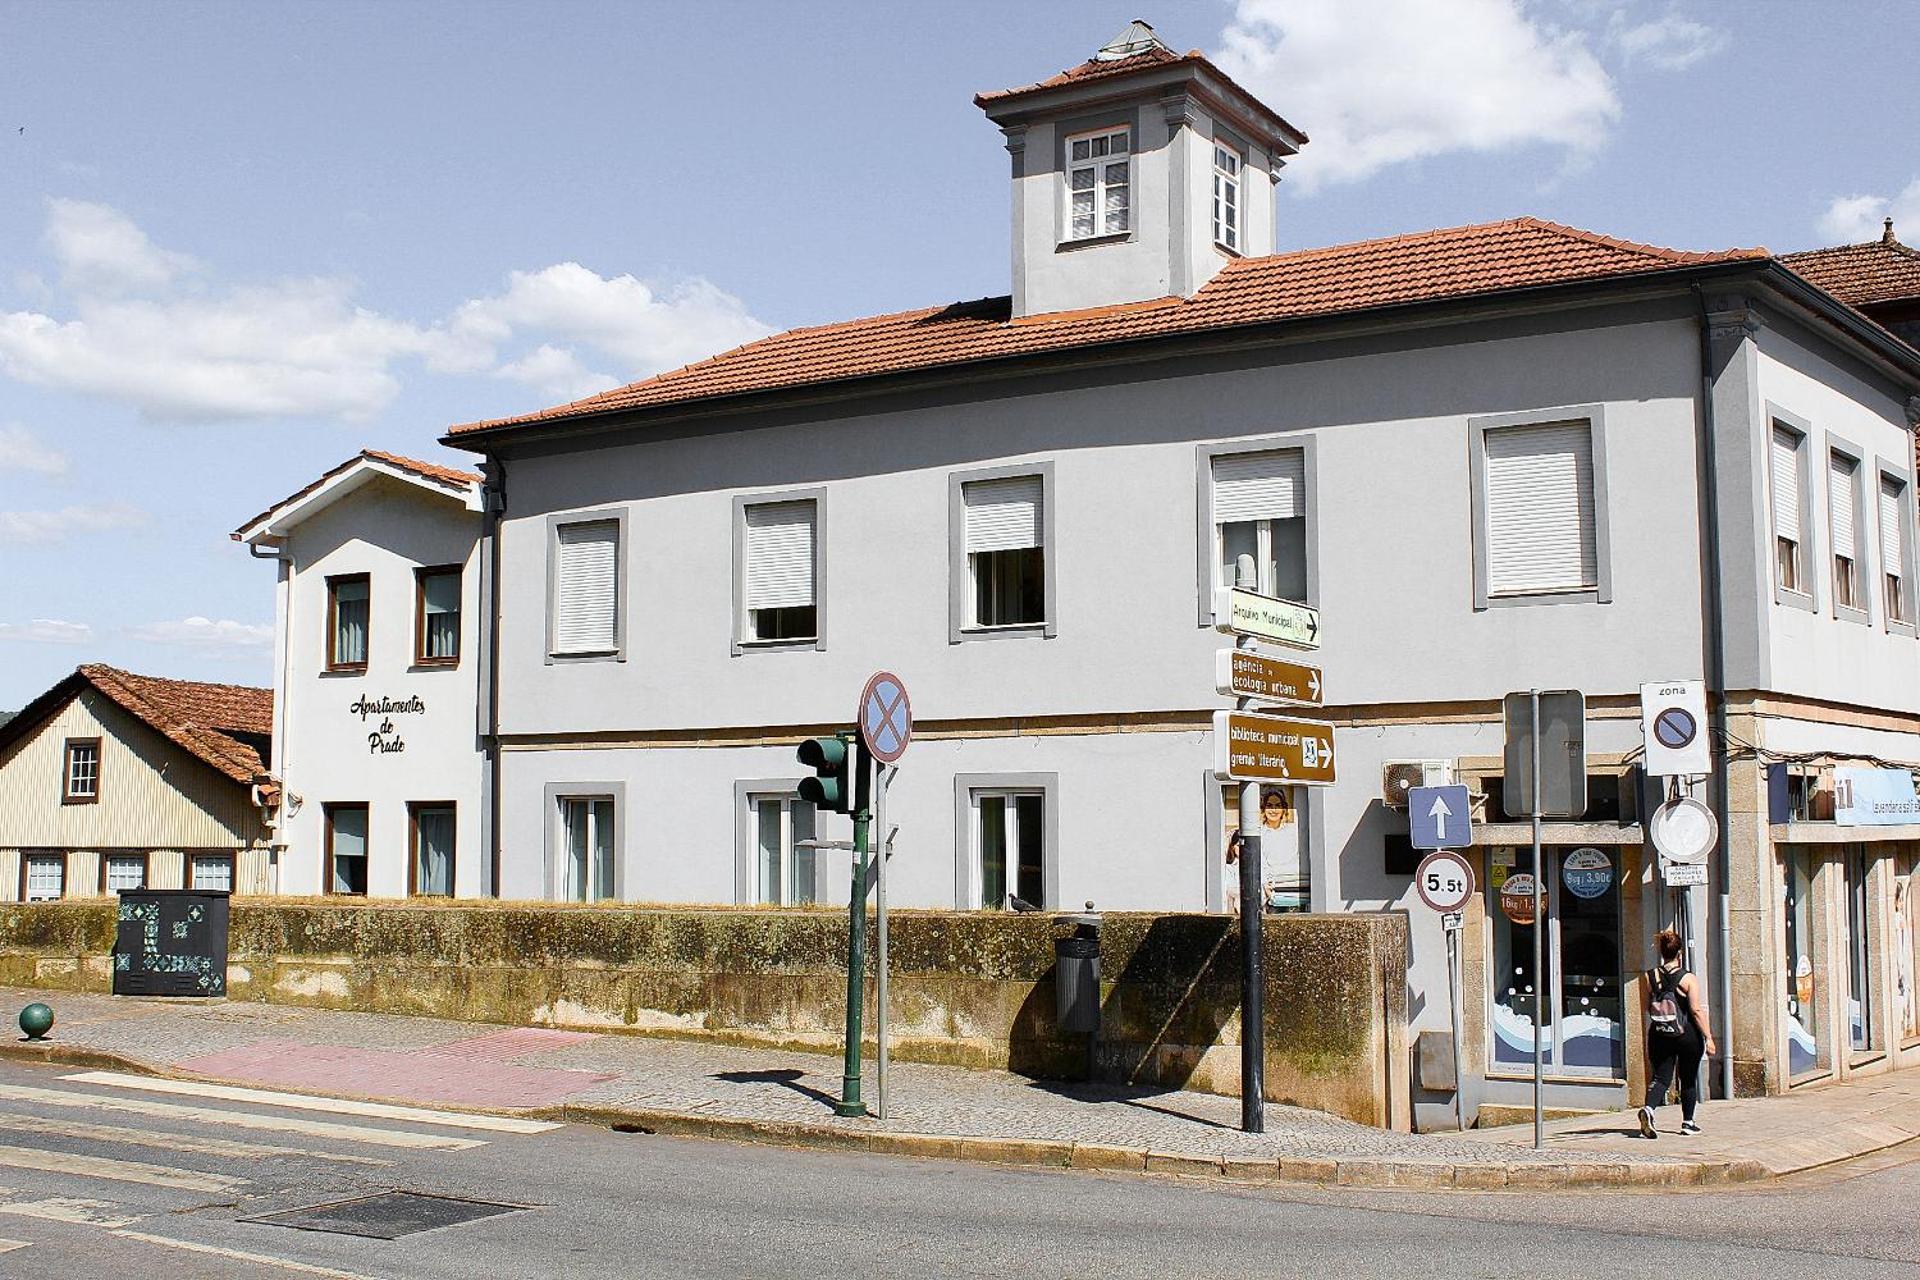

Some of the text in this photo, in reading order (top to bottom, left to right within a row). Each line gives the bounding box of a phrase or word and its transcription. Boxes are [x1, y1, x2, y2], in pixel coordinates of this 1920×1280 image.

[1233, 604, 1293, 629] Arquivo Municipal
[1233, 658, 1263, 674] agência
[1233, 675, 1297, 696] ecologia urbana
[1659, 686, 1686, 696] zona
[350, 693, 425, 722] Apartamentos
[380, 716, 394, 734] de
[368, 732, 405, 754] Prado
[1230, 726, 1300, 748] biblioteca municipal
[1230, 751, 1286, 768] grémio literário
[1428, 873, 1463, 893] 5.5t
